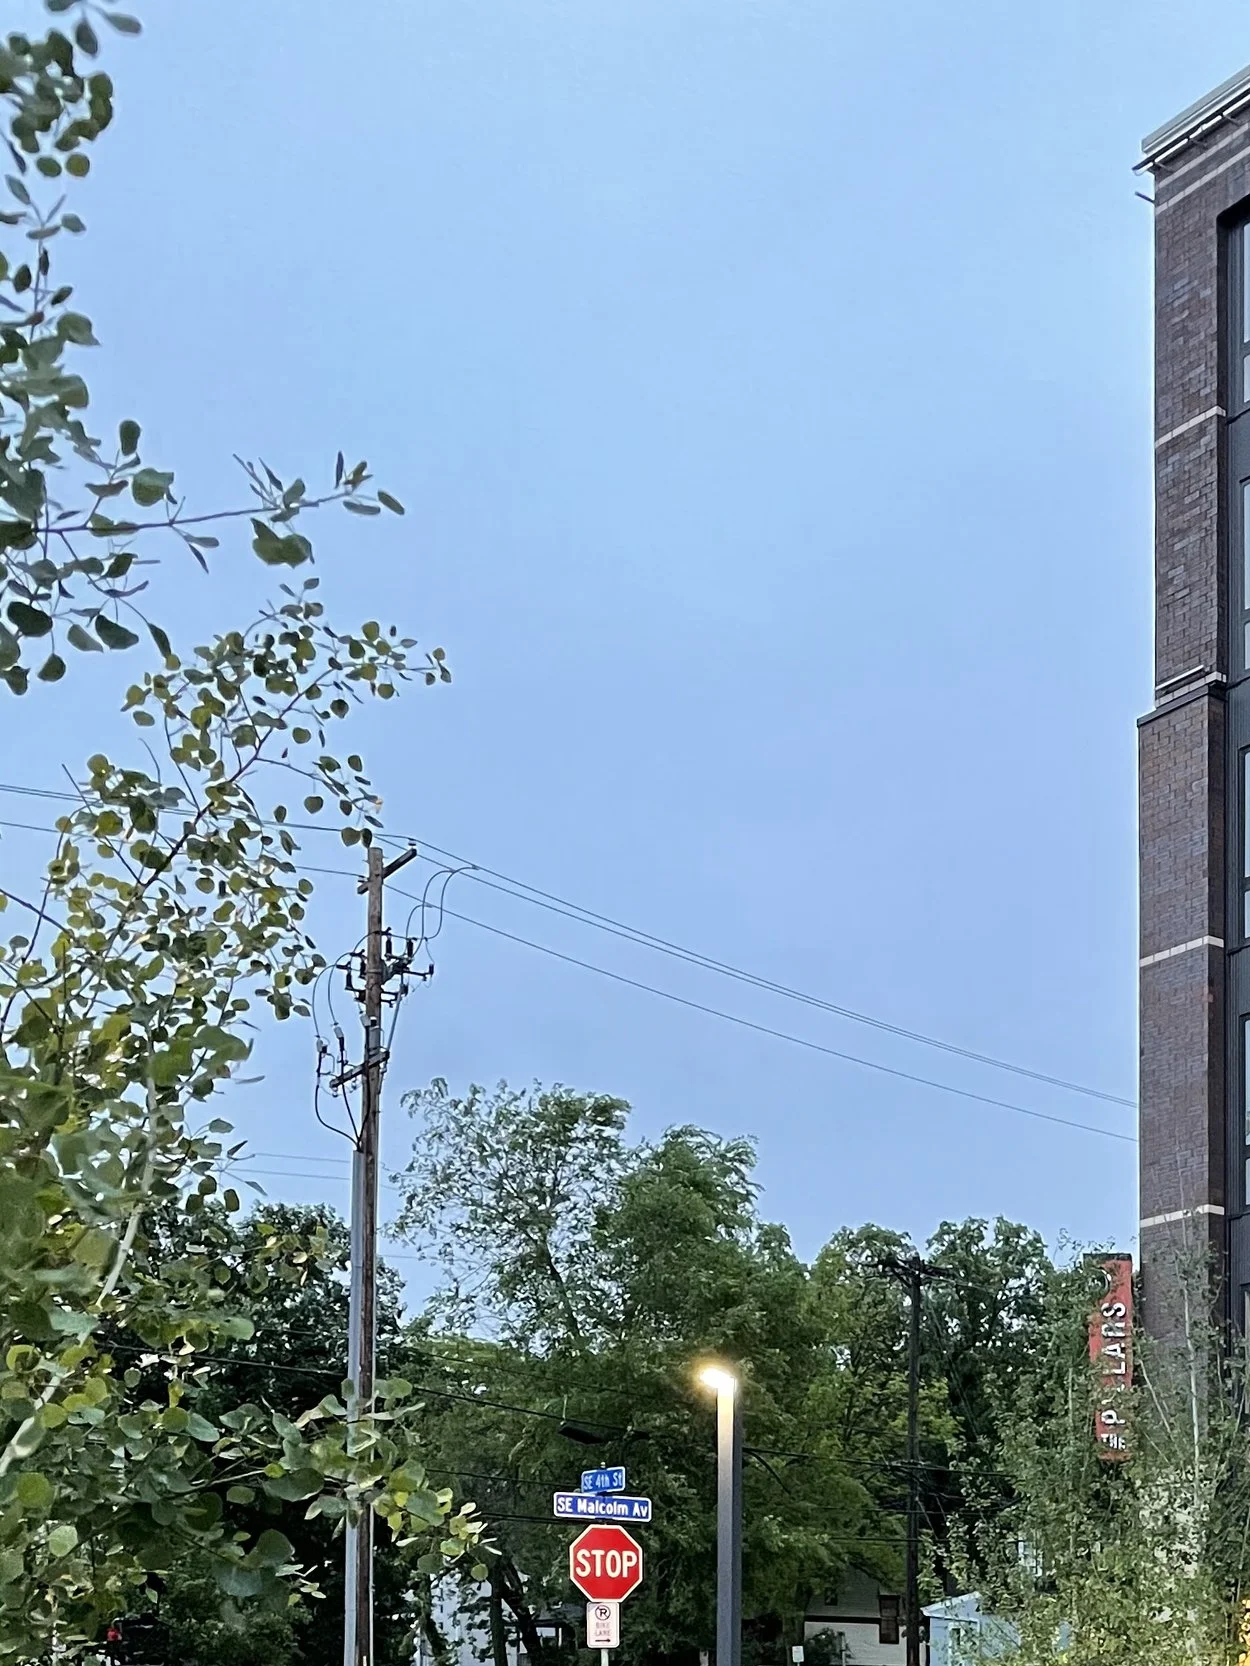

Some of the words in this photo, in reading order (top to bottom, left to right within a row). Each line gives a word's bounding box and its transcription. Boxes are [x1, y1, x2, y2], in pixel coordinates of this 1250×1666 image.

[1101, 1302, 1126, 1424] PLARS
[583, 1475, 593, 1490] SE
[596, 1474, 610, 1488] 4th
[613, 1472, 622, 1487] St
[557, 1497, 573, 1513] SE
[577, 1498, 628, 1516] Malcolm
[633, 1502, 648, 1517] Av
[576, 1549, 638, 1578] STOP
